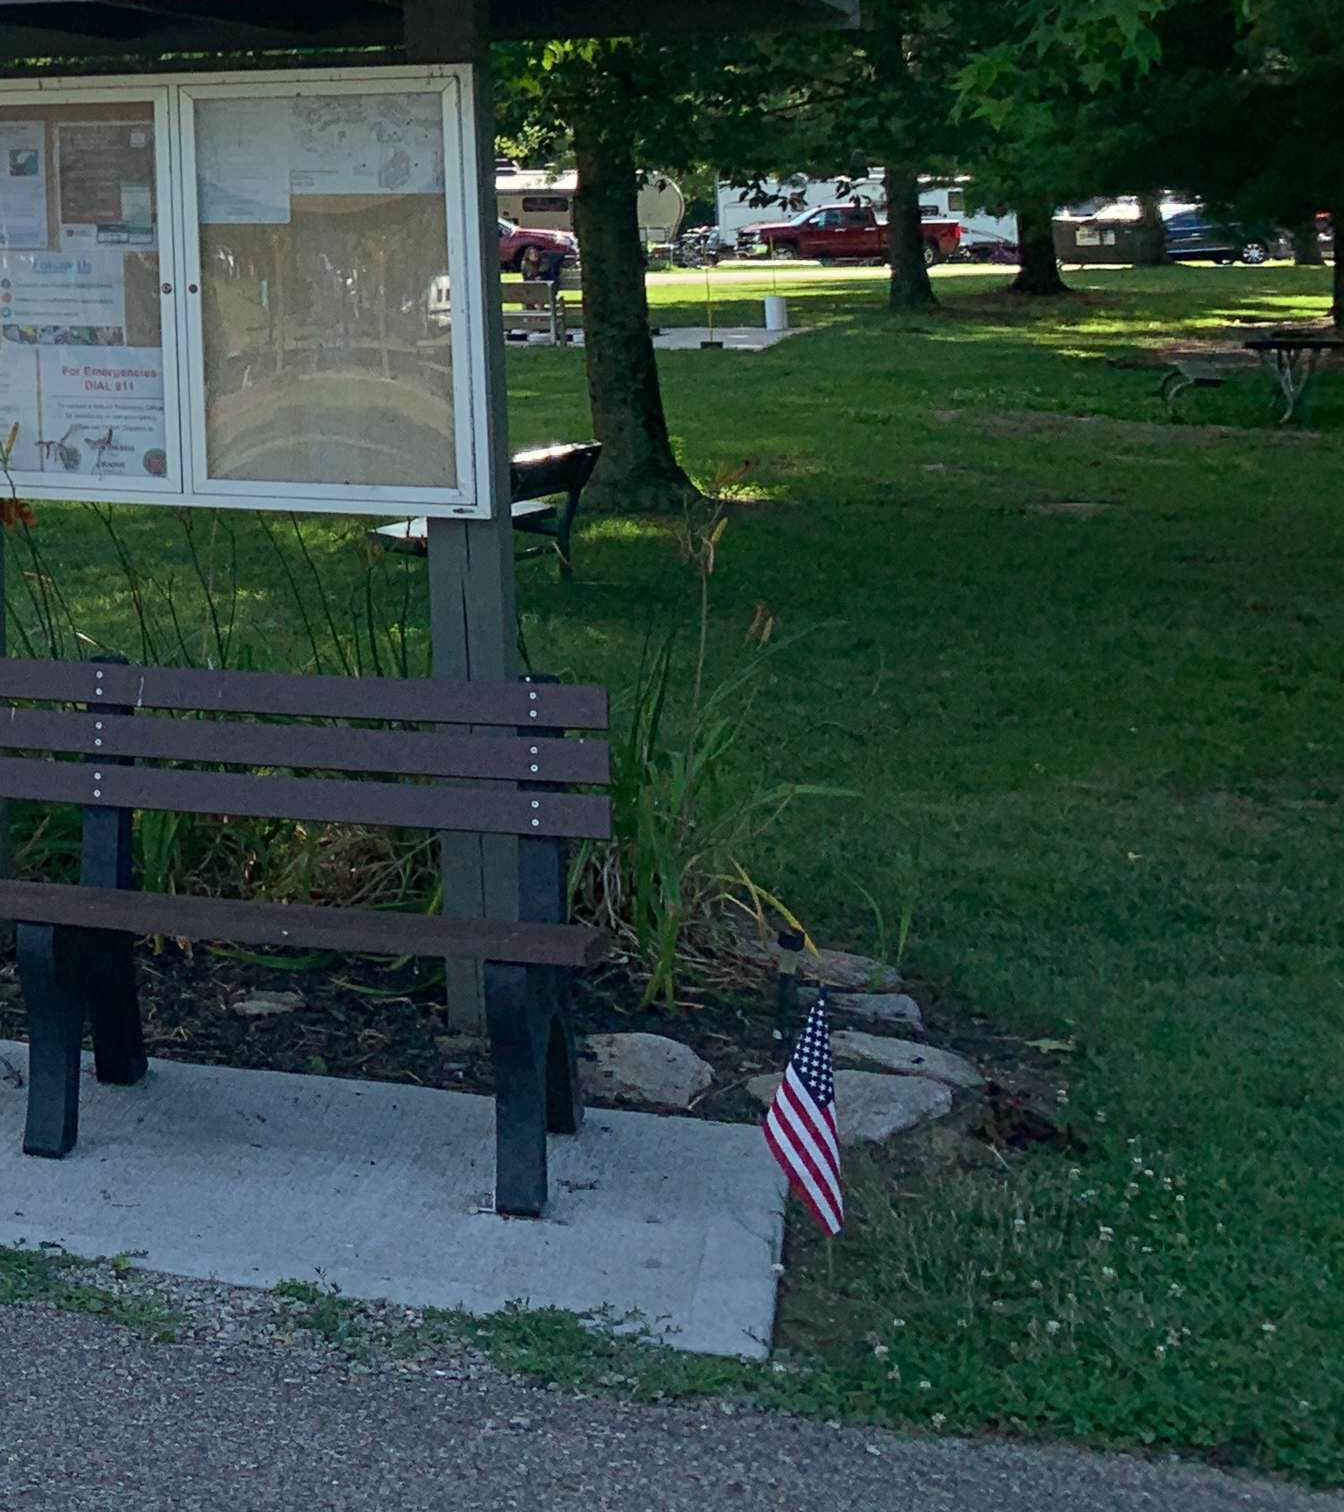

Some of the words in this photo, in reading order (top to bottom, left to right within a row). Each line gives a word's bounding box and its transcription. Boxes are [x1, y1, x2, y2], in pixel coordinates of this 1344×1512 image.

[62, 366, 80, 376] For
[83, 366, 158, 379] Emergencies
[84, 380, 112, 391] DIAL
